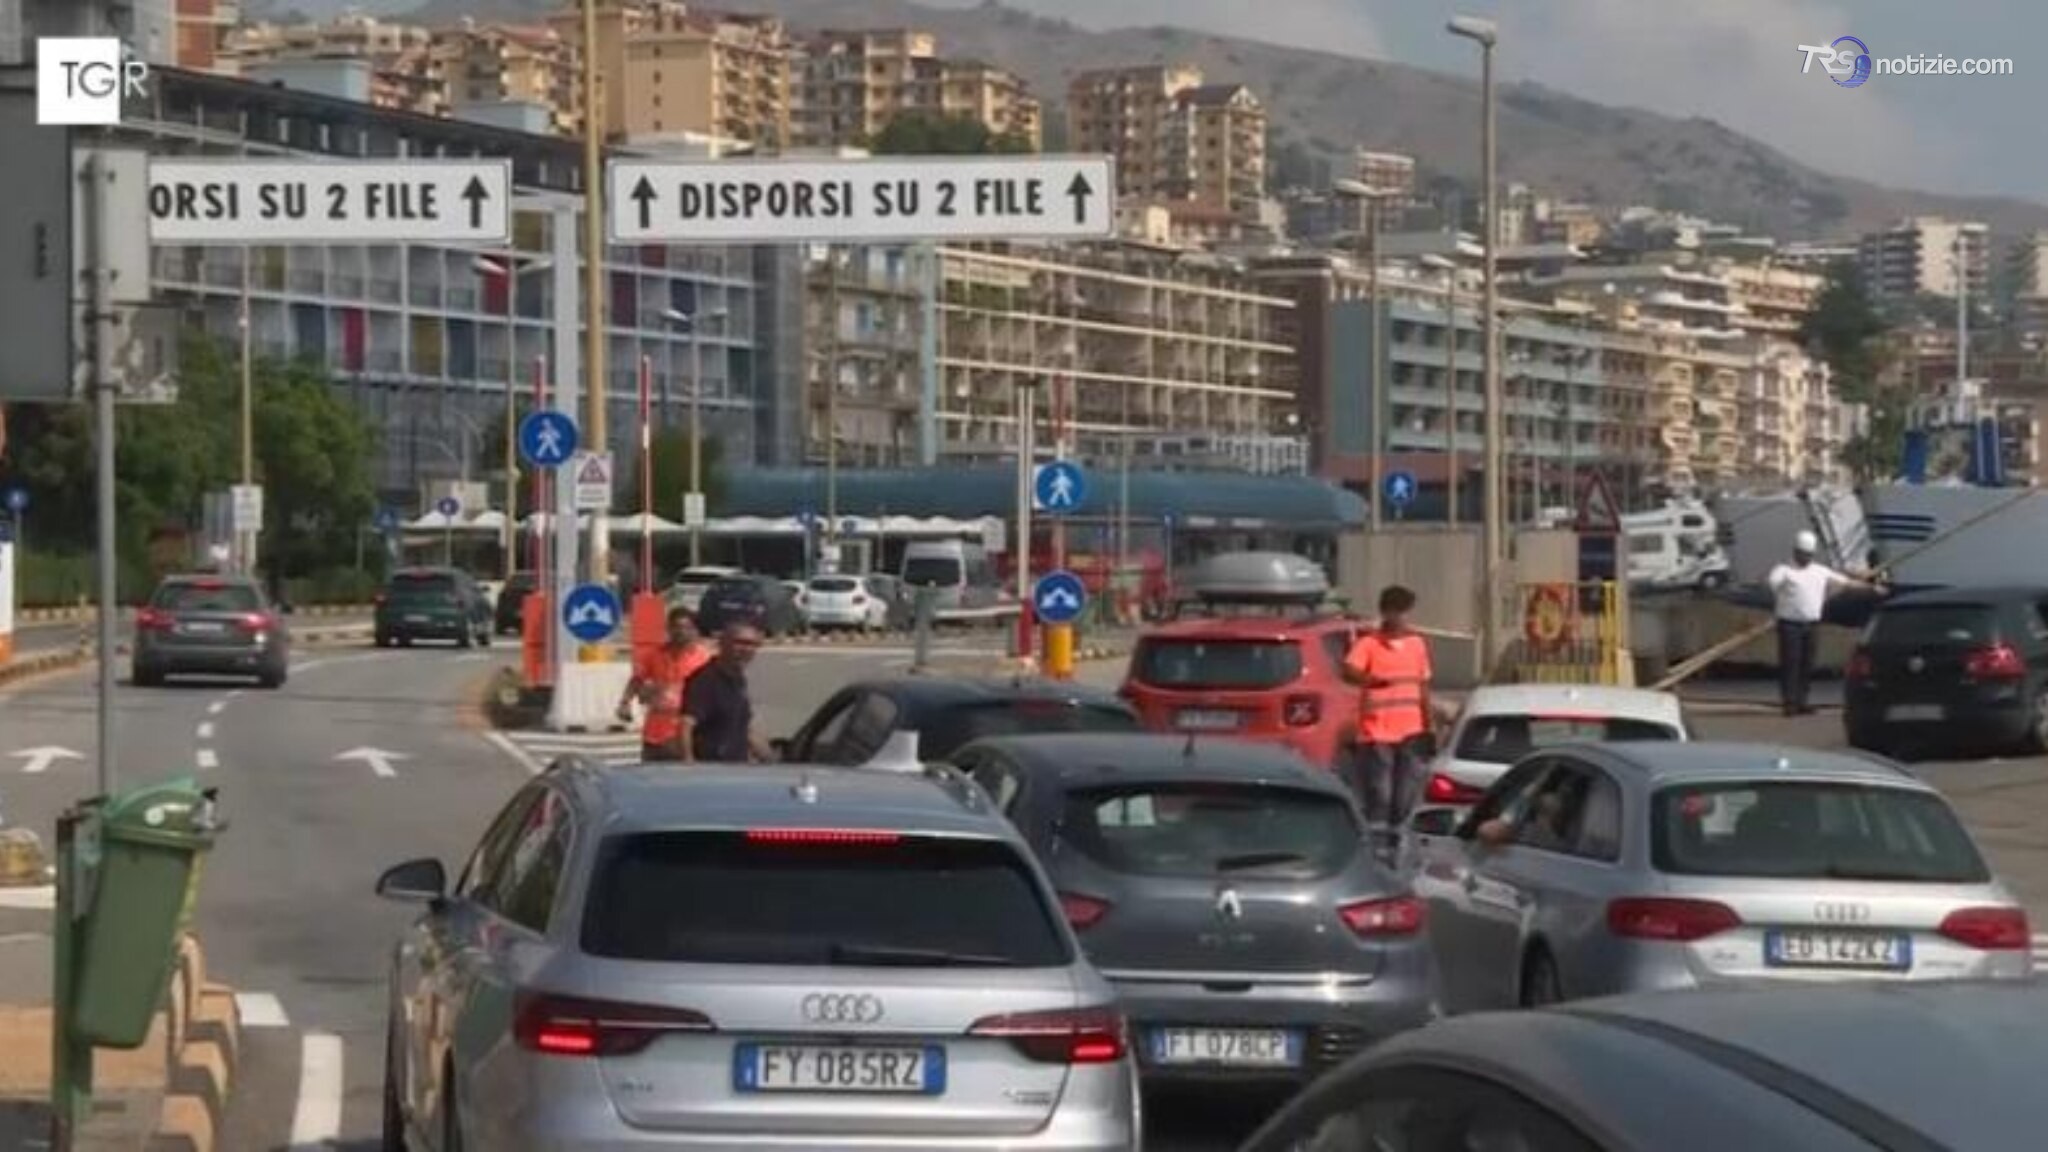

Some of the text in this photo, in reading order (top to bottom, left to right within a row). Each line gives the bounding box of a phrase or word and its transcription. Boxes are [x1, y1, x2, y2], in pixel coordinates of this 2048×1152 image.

[150, 182, 438, 220] ORSI SU 2 FILE
[679, 179, 1044, 219] DISPORSI SU 2 FILE
[764, 1049, 920, 1086] FY 085RZ
